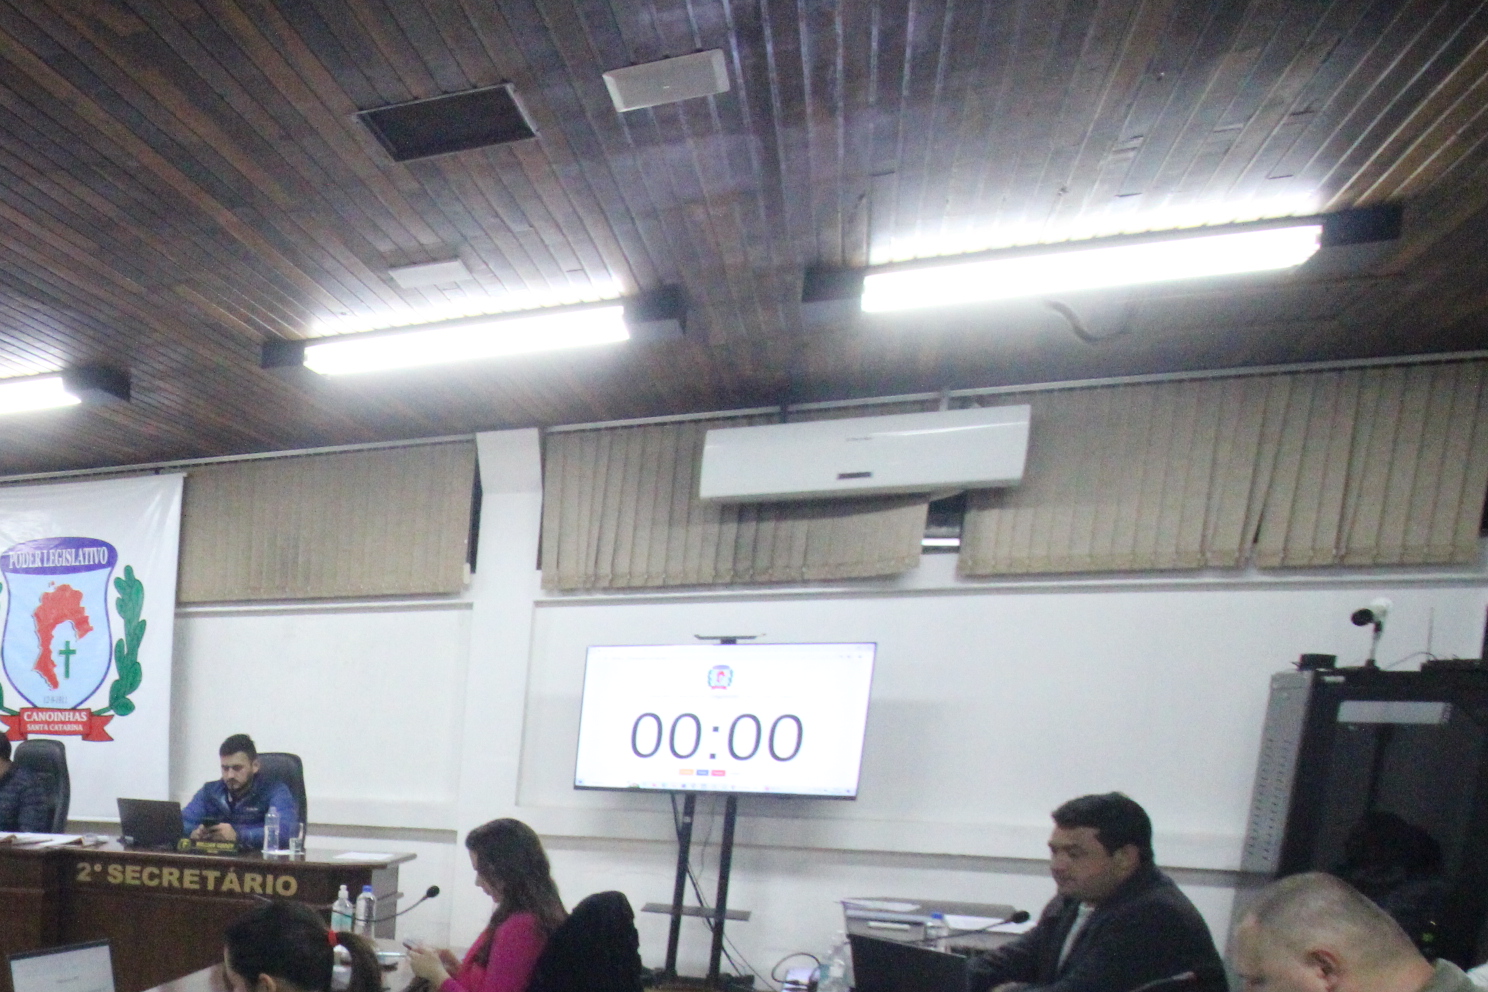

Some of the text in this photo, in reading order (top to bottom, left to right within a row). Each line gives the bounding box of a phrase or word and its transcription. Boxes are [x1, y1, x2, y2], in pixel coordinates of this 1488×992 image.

[9, 547, 108, 568] PODER LEGISLATIVO
[23, 711, 88, 722] CANOINHAS
[26, 723, 83, 731] SANTA CATARINA
[630, 712, 804, 762] 00:00
[107, 864, 298, 896] SECRETÁRIO
